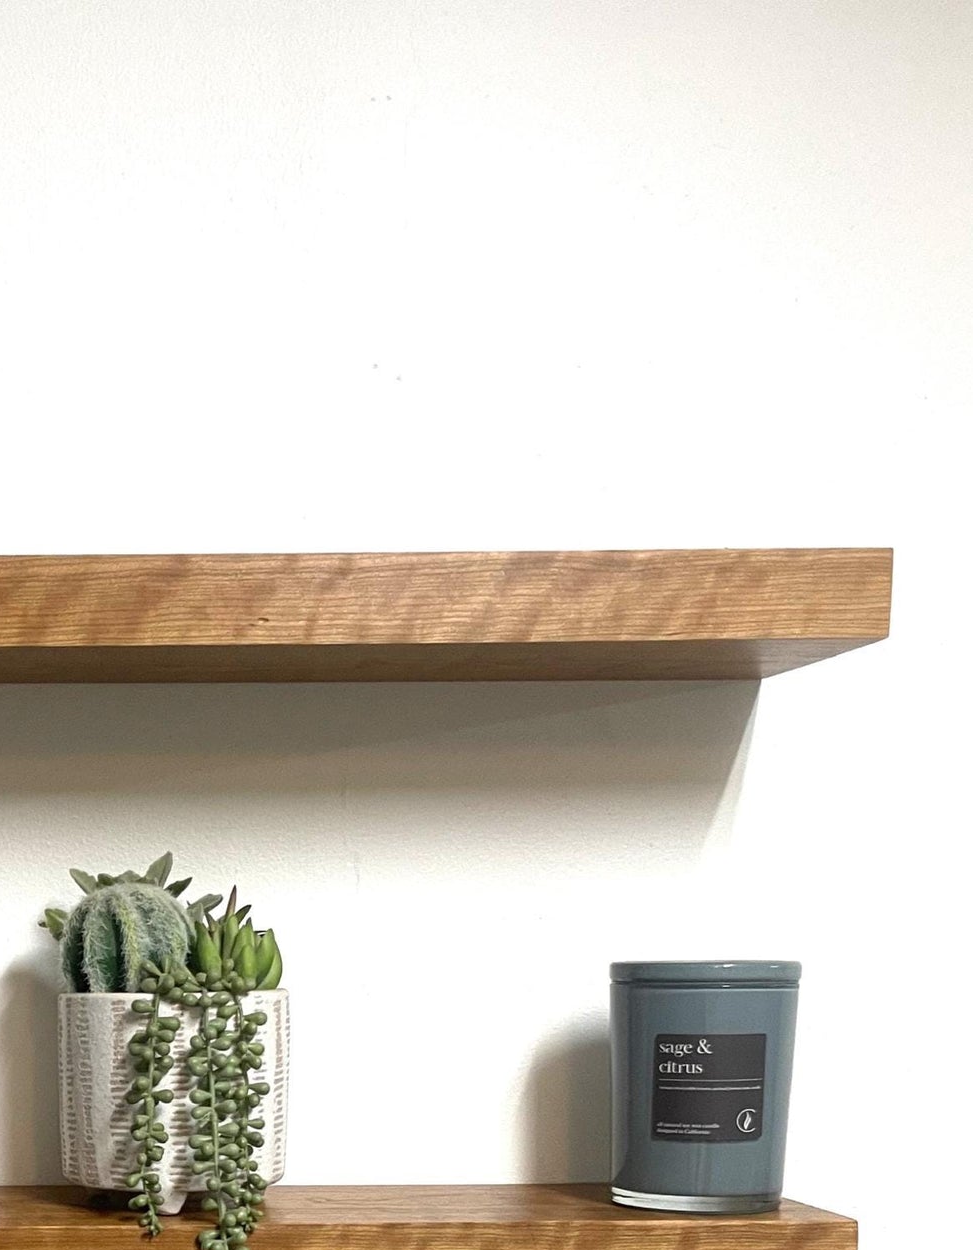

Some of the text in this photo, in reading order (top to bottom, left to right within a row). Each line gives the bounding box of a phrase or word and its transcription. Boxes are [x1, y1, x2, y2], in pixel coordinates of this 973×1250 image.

[658, 1038, 713, 1057] sage &
[658, 1060, 703, 1074] citrus
